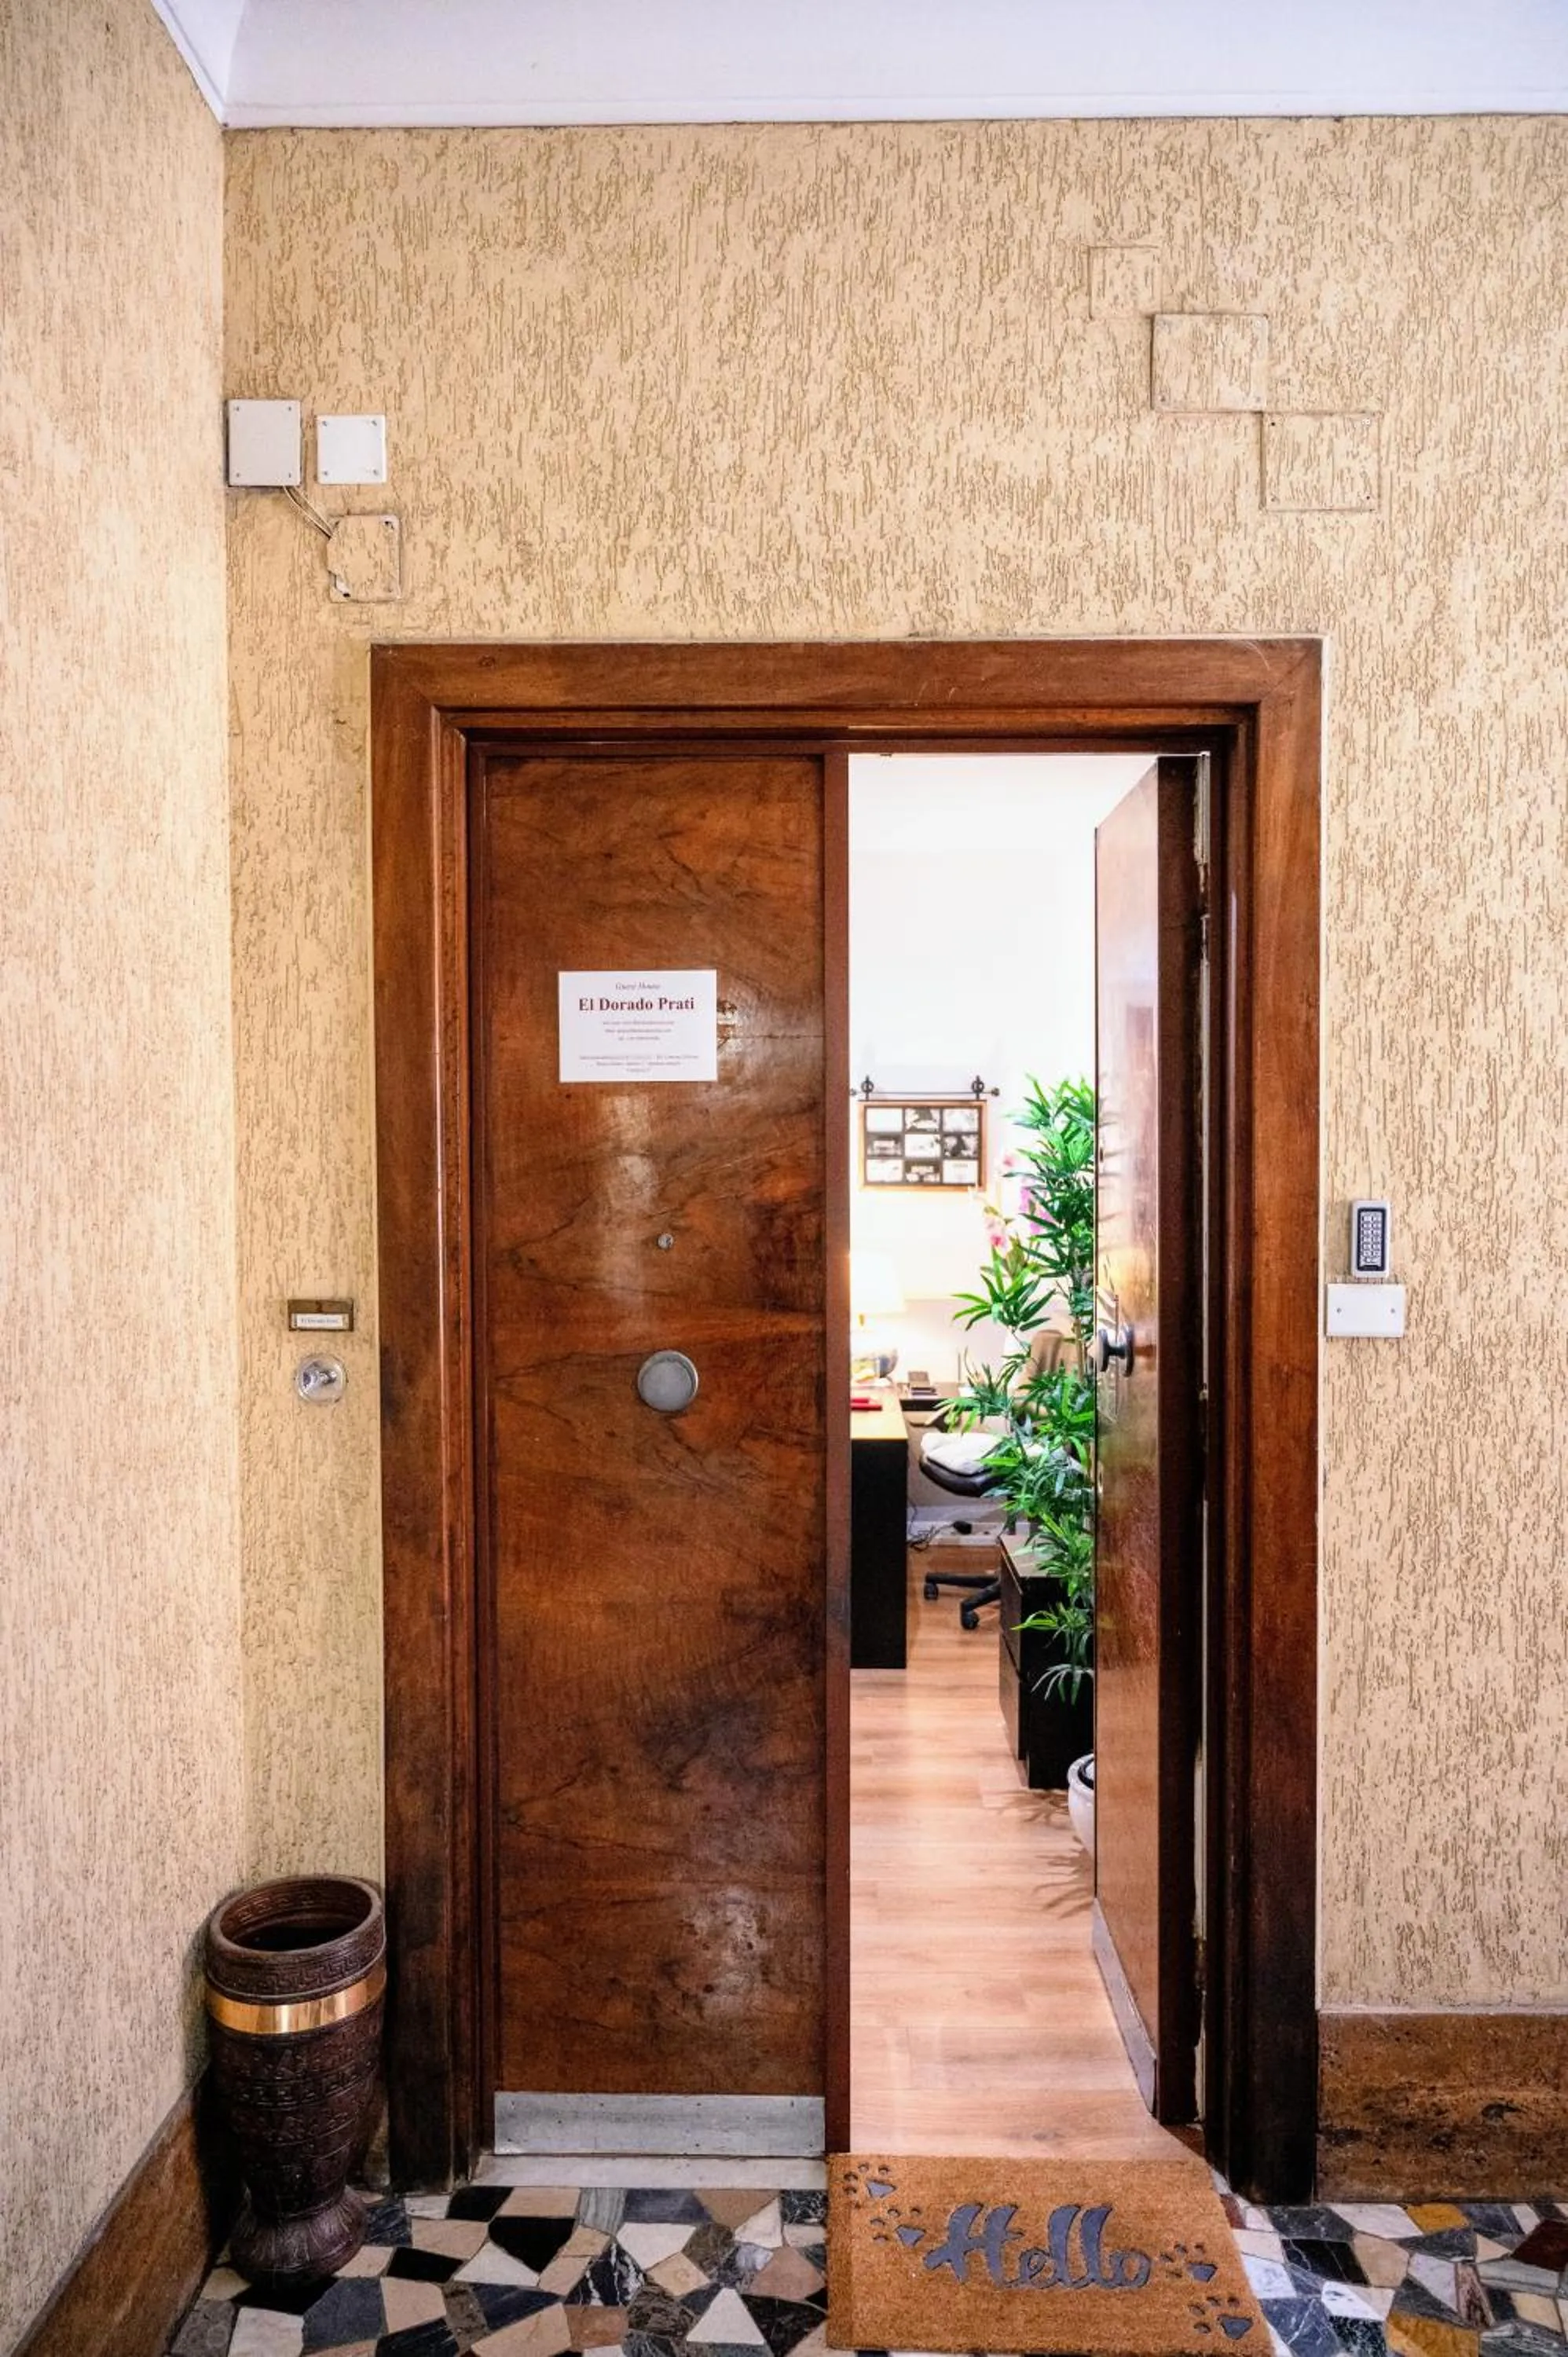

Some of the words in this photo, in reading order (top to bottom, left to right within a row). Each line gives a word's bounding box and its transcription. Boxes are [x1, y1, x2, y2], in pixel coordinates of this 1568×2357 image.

[578, 998, 595, 1011] El
[599, 997, 654, 1011] Dorado
[658, 996, 695, 1010] Prati
[923, 2201, 1152, 2289] Hello
